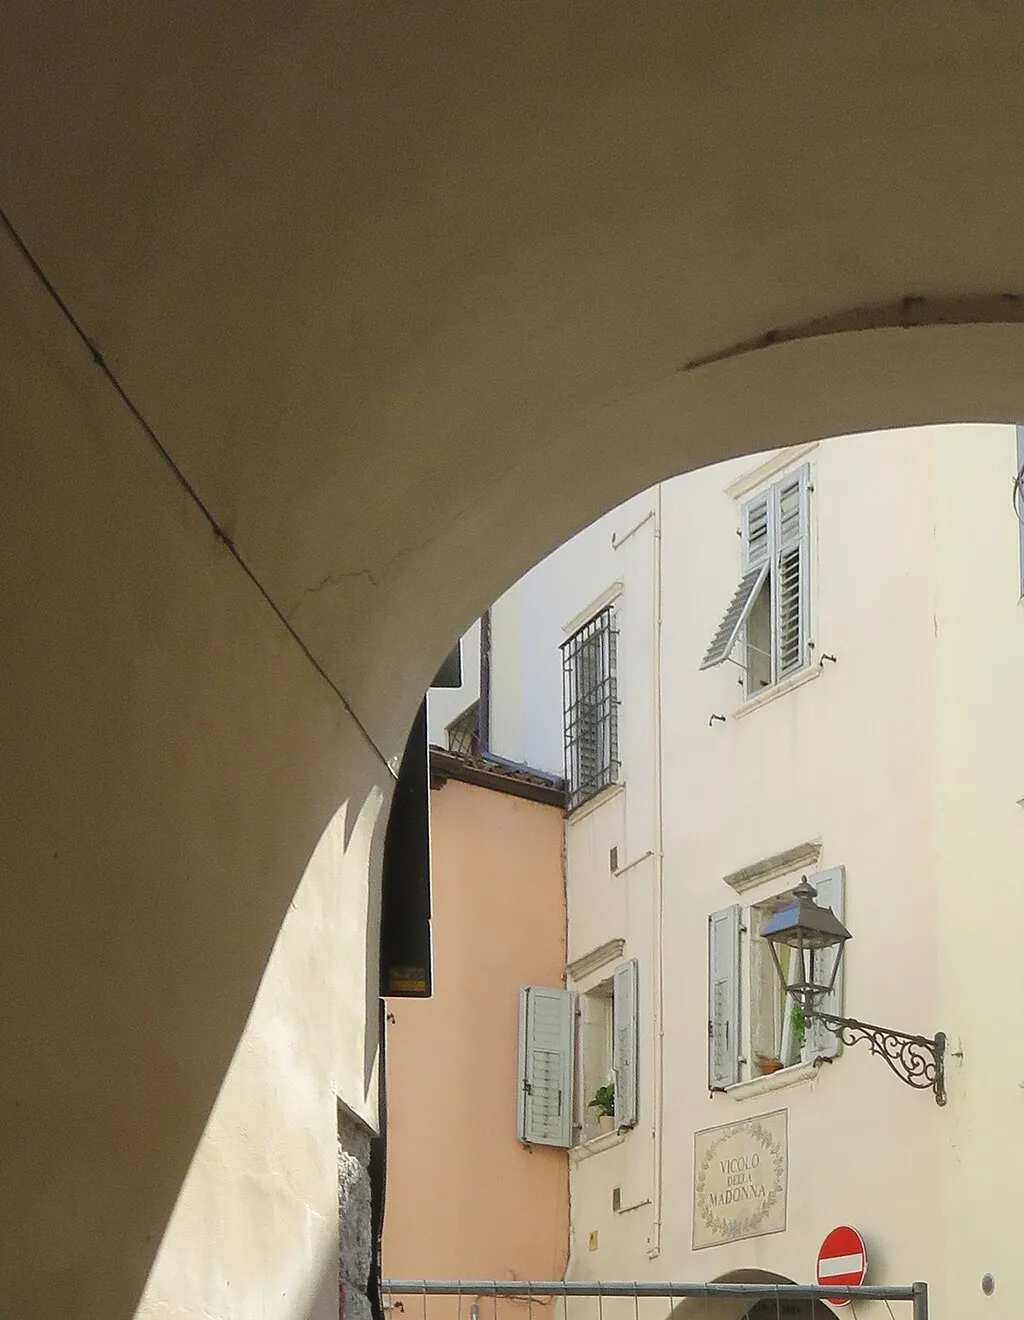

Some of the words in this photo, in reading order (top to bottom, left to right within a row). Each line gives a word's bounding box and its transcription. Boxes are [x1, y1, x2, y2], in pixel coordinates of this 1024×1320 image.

[720, 1153, 760, 1174] VICOLO
[727, 1173, 752, 1187] DELLA
[709, 1184, 766, 1207] MADONNA
